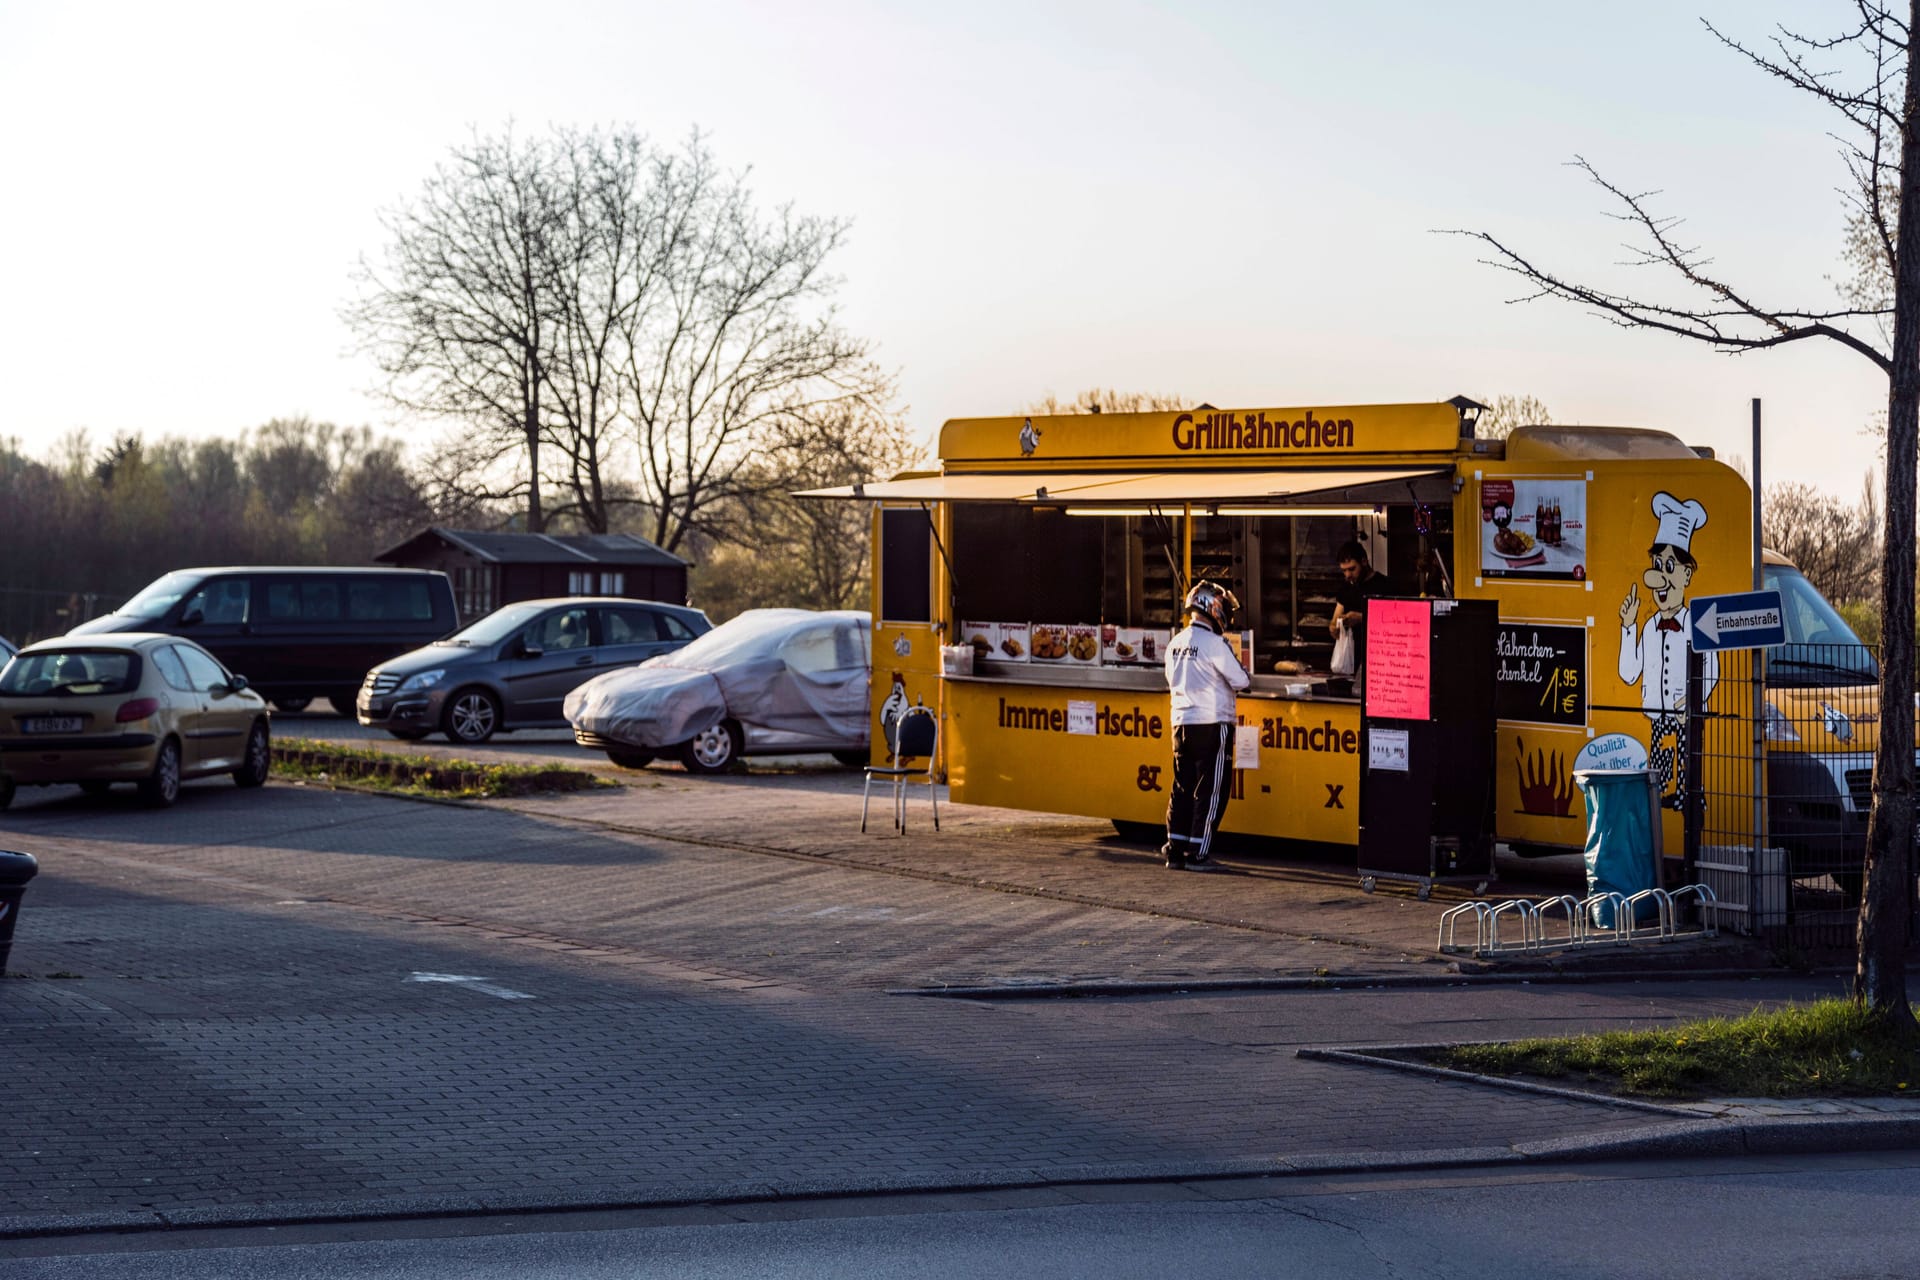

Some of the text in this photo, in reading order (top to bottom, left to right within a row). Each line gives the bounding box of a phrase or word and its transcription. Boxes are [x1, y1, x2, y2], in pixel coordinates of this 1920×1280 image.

[1172, 411, 1354, 450] Grillhähnchen
[1716, 612, 1778, 629] Einbahnstraße
[1496, 659, 1543, 683] chenkel
[1562, 694, 1578, 713] €
[1096, 705, 1163, 739] rische
[1587, 737, 1627, 758] Qualität
[1137, 764, 1163, 792] &
